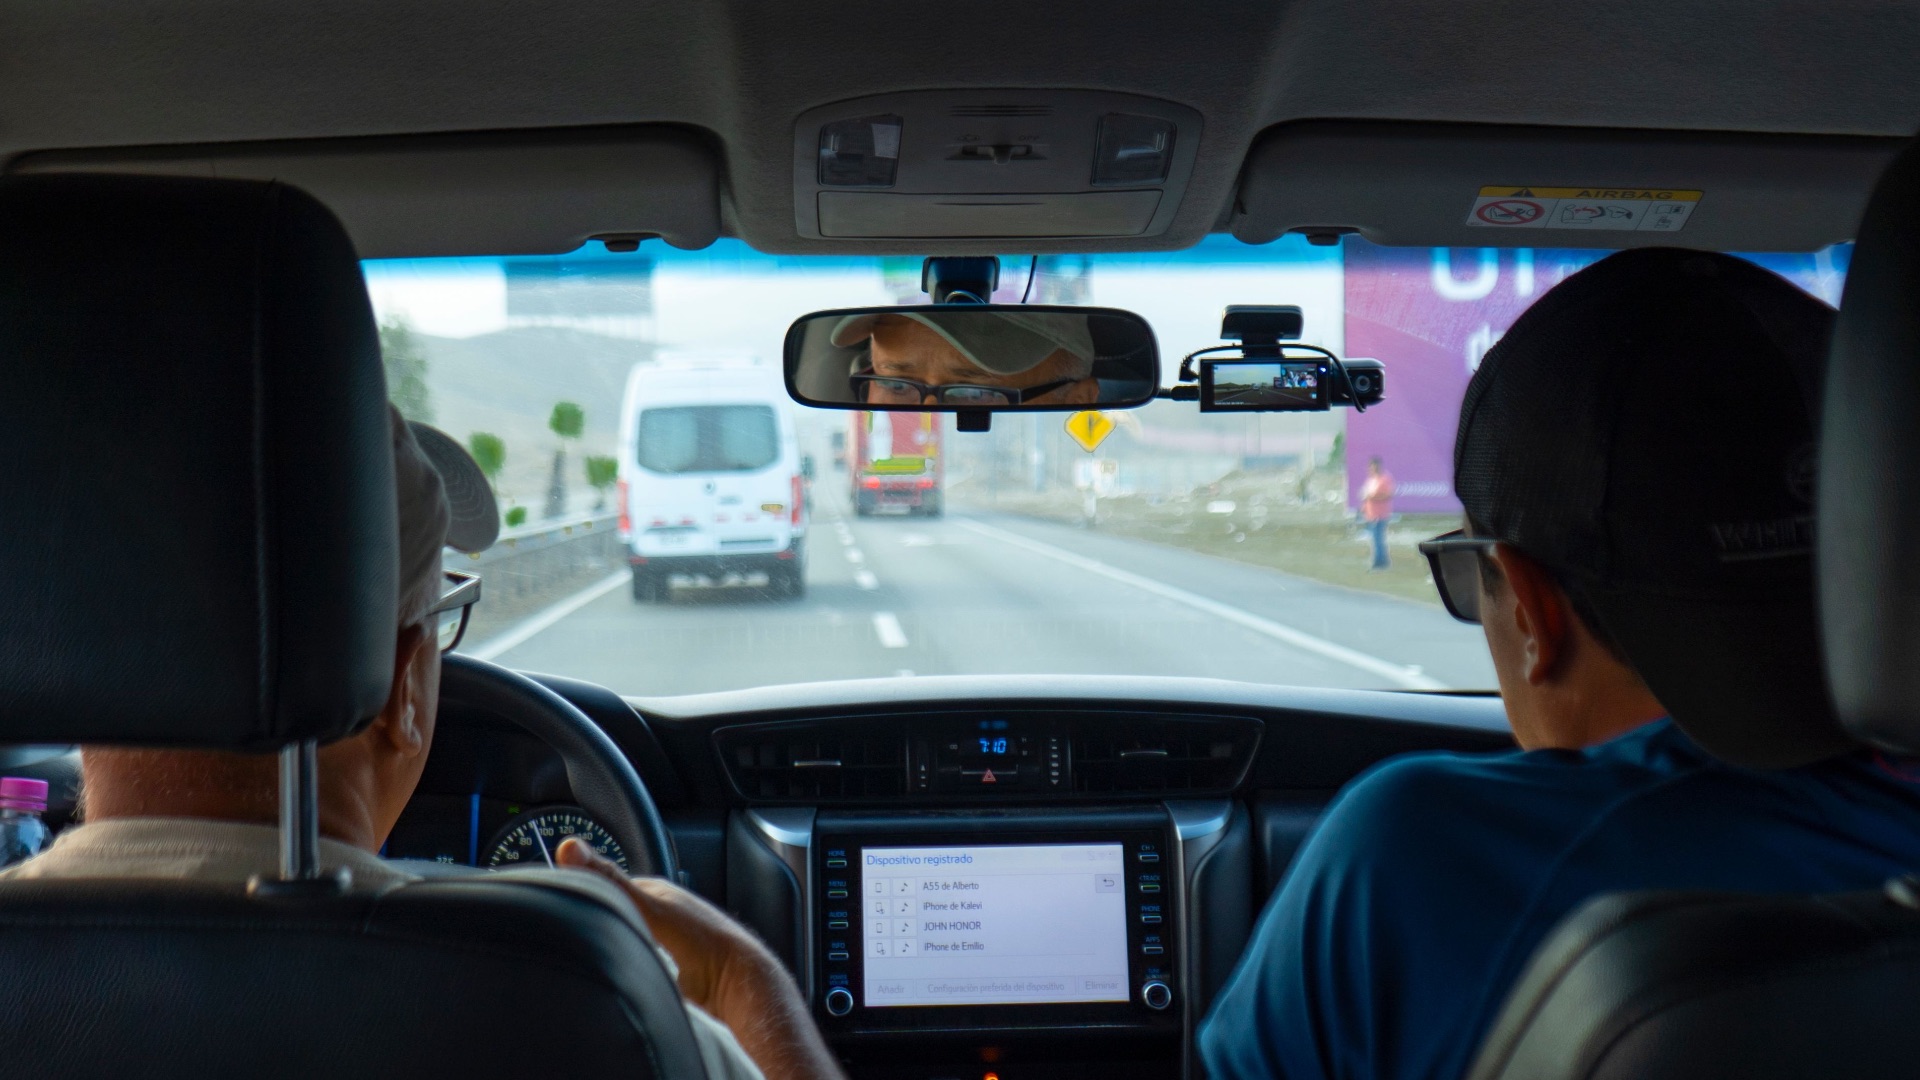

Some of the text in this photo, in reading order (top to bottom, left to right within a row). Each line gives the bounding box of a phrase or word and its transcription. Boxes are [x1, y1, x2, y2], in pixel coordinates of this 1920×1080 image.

[1575, 190, 1673, 200] AIRBAG
[979, 738, 1007, 754] 7:10
[519, 837, 533, 846] 80
[506, 851, 520, 860] 60
[866, 854, 973, 867] Dispositivo registrado
[923, 881, 979, 891] A55 de Alberto
[923, 901, 982, 911] iPhone de Kalevi
[924, 921, 982, 931] JOHN HONOR
[924, 941, 984, 951] iPhone de Emilio
[877, 984, 905, 994] Añadir
[927, 981, 1065, 994] Configuración preferida del dispositivo
[1085, 980, 1119, 990] Eliminar
